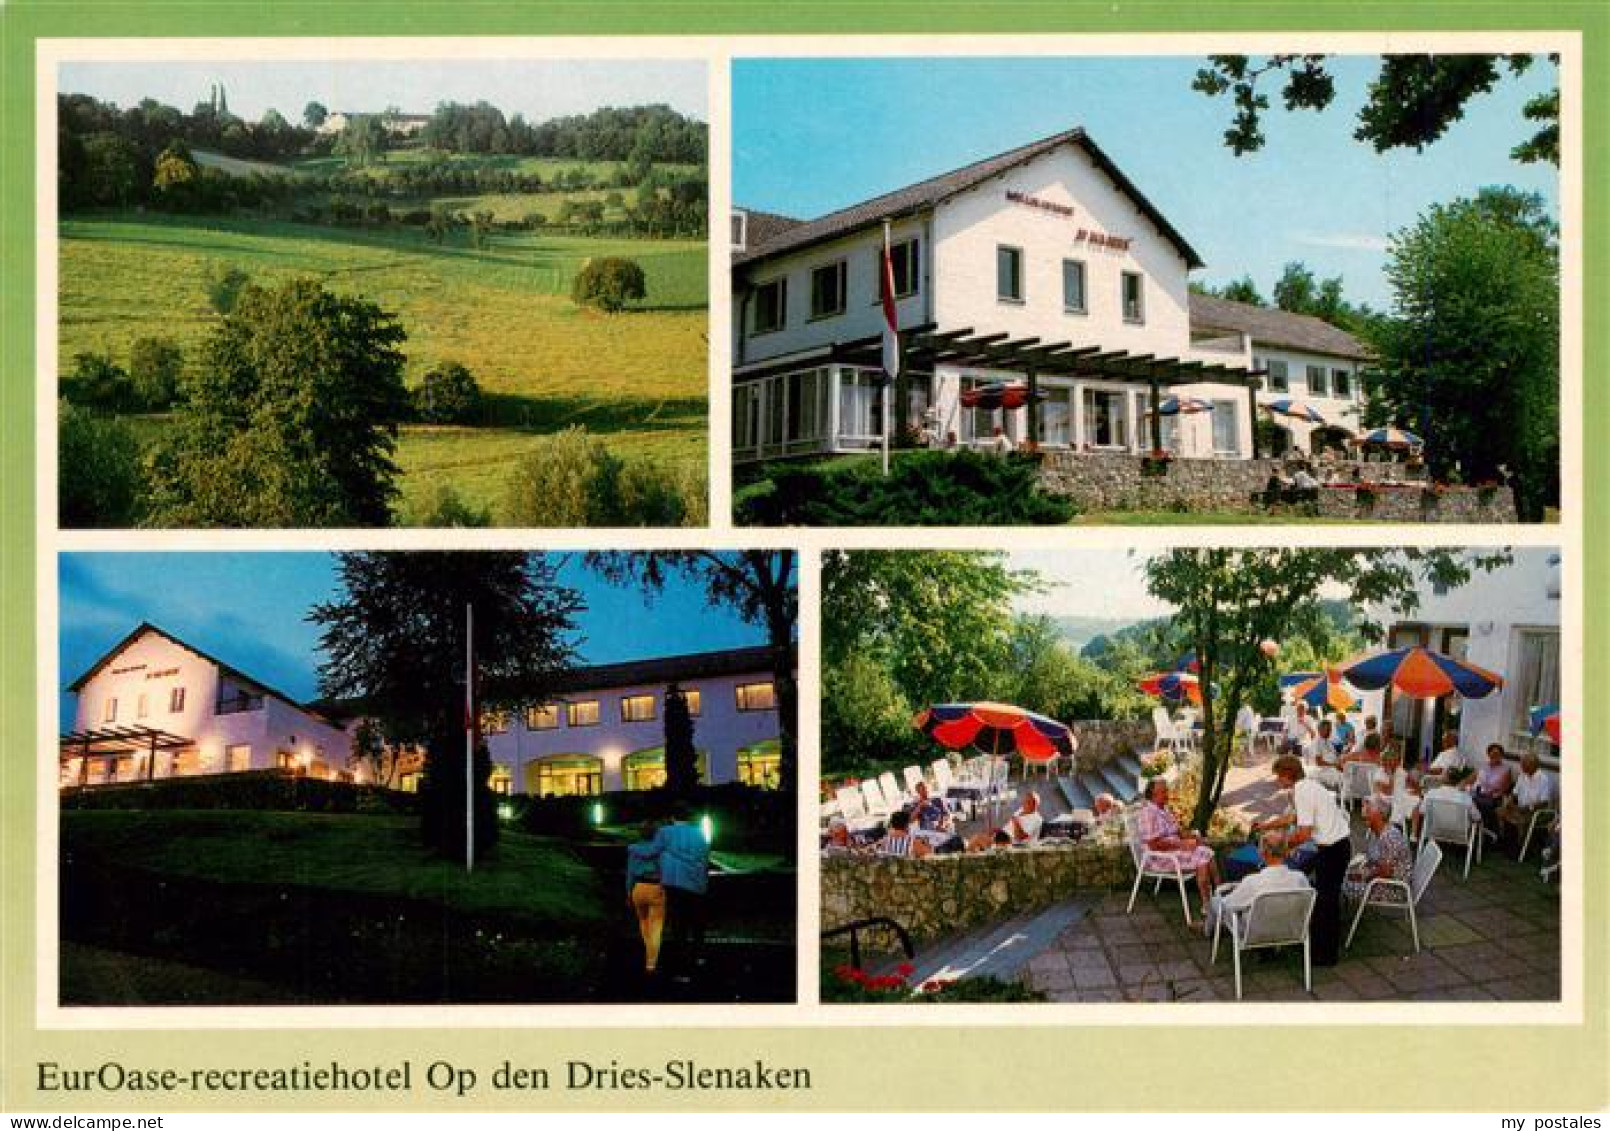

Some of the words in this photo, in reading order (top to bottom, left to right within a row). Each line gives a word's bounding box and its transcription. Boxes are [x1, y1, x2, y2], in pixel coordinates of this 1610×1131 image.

[36, 1061, 411, 1091] EurOase-recreatiehotel
[427, 1061, 477, 1096] Op
[491, 1060, 549, 1089] den
[567, 1059, 811, 1090] Dries-Slenaken
